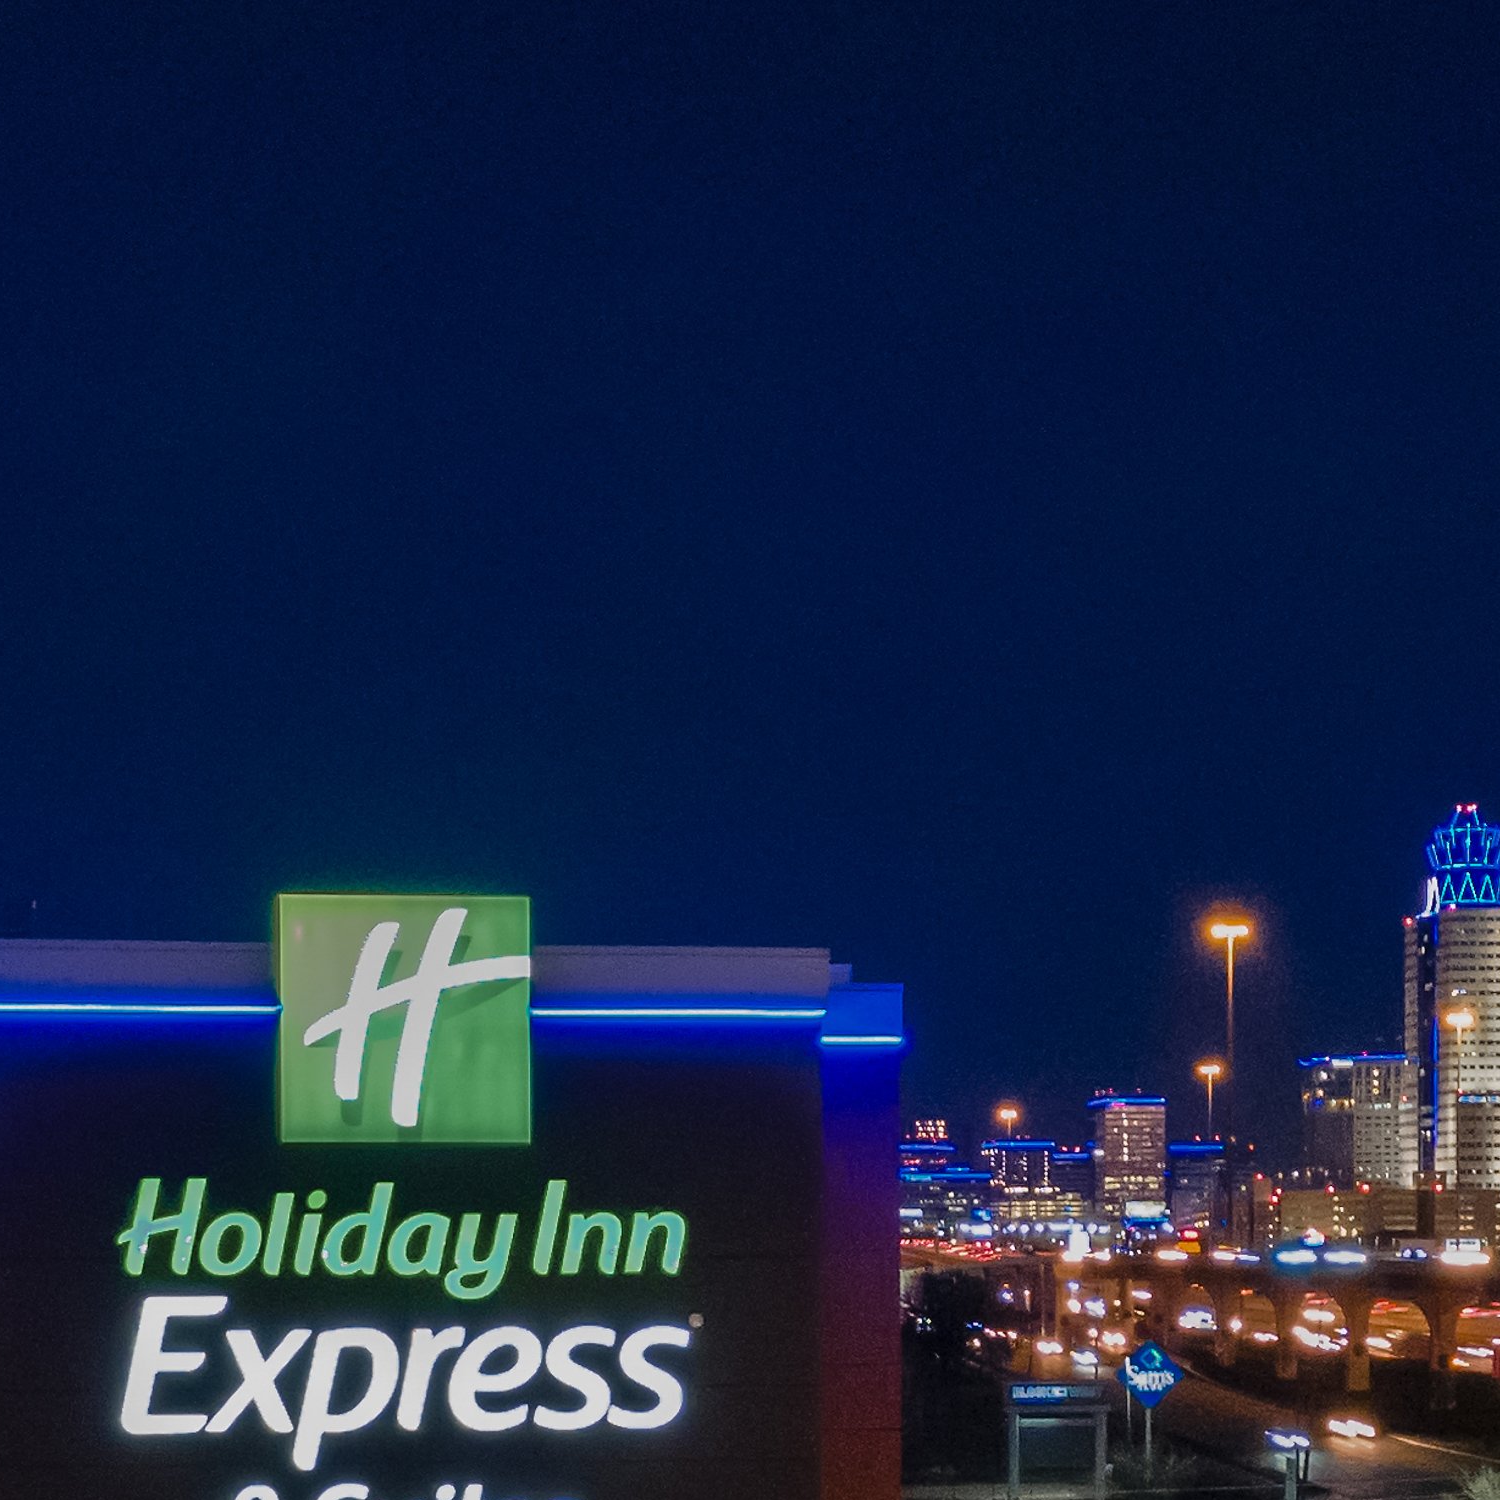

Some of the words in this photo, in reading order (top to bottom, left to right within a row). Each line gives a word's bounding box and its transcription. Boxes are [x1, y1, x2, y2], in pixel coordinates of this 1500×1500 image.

[117, 1177, 519, 1300] Holiday
[532, 1179, 687, 1276] Inn
[120, 1295, 691, 1471] Express
